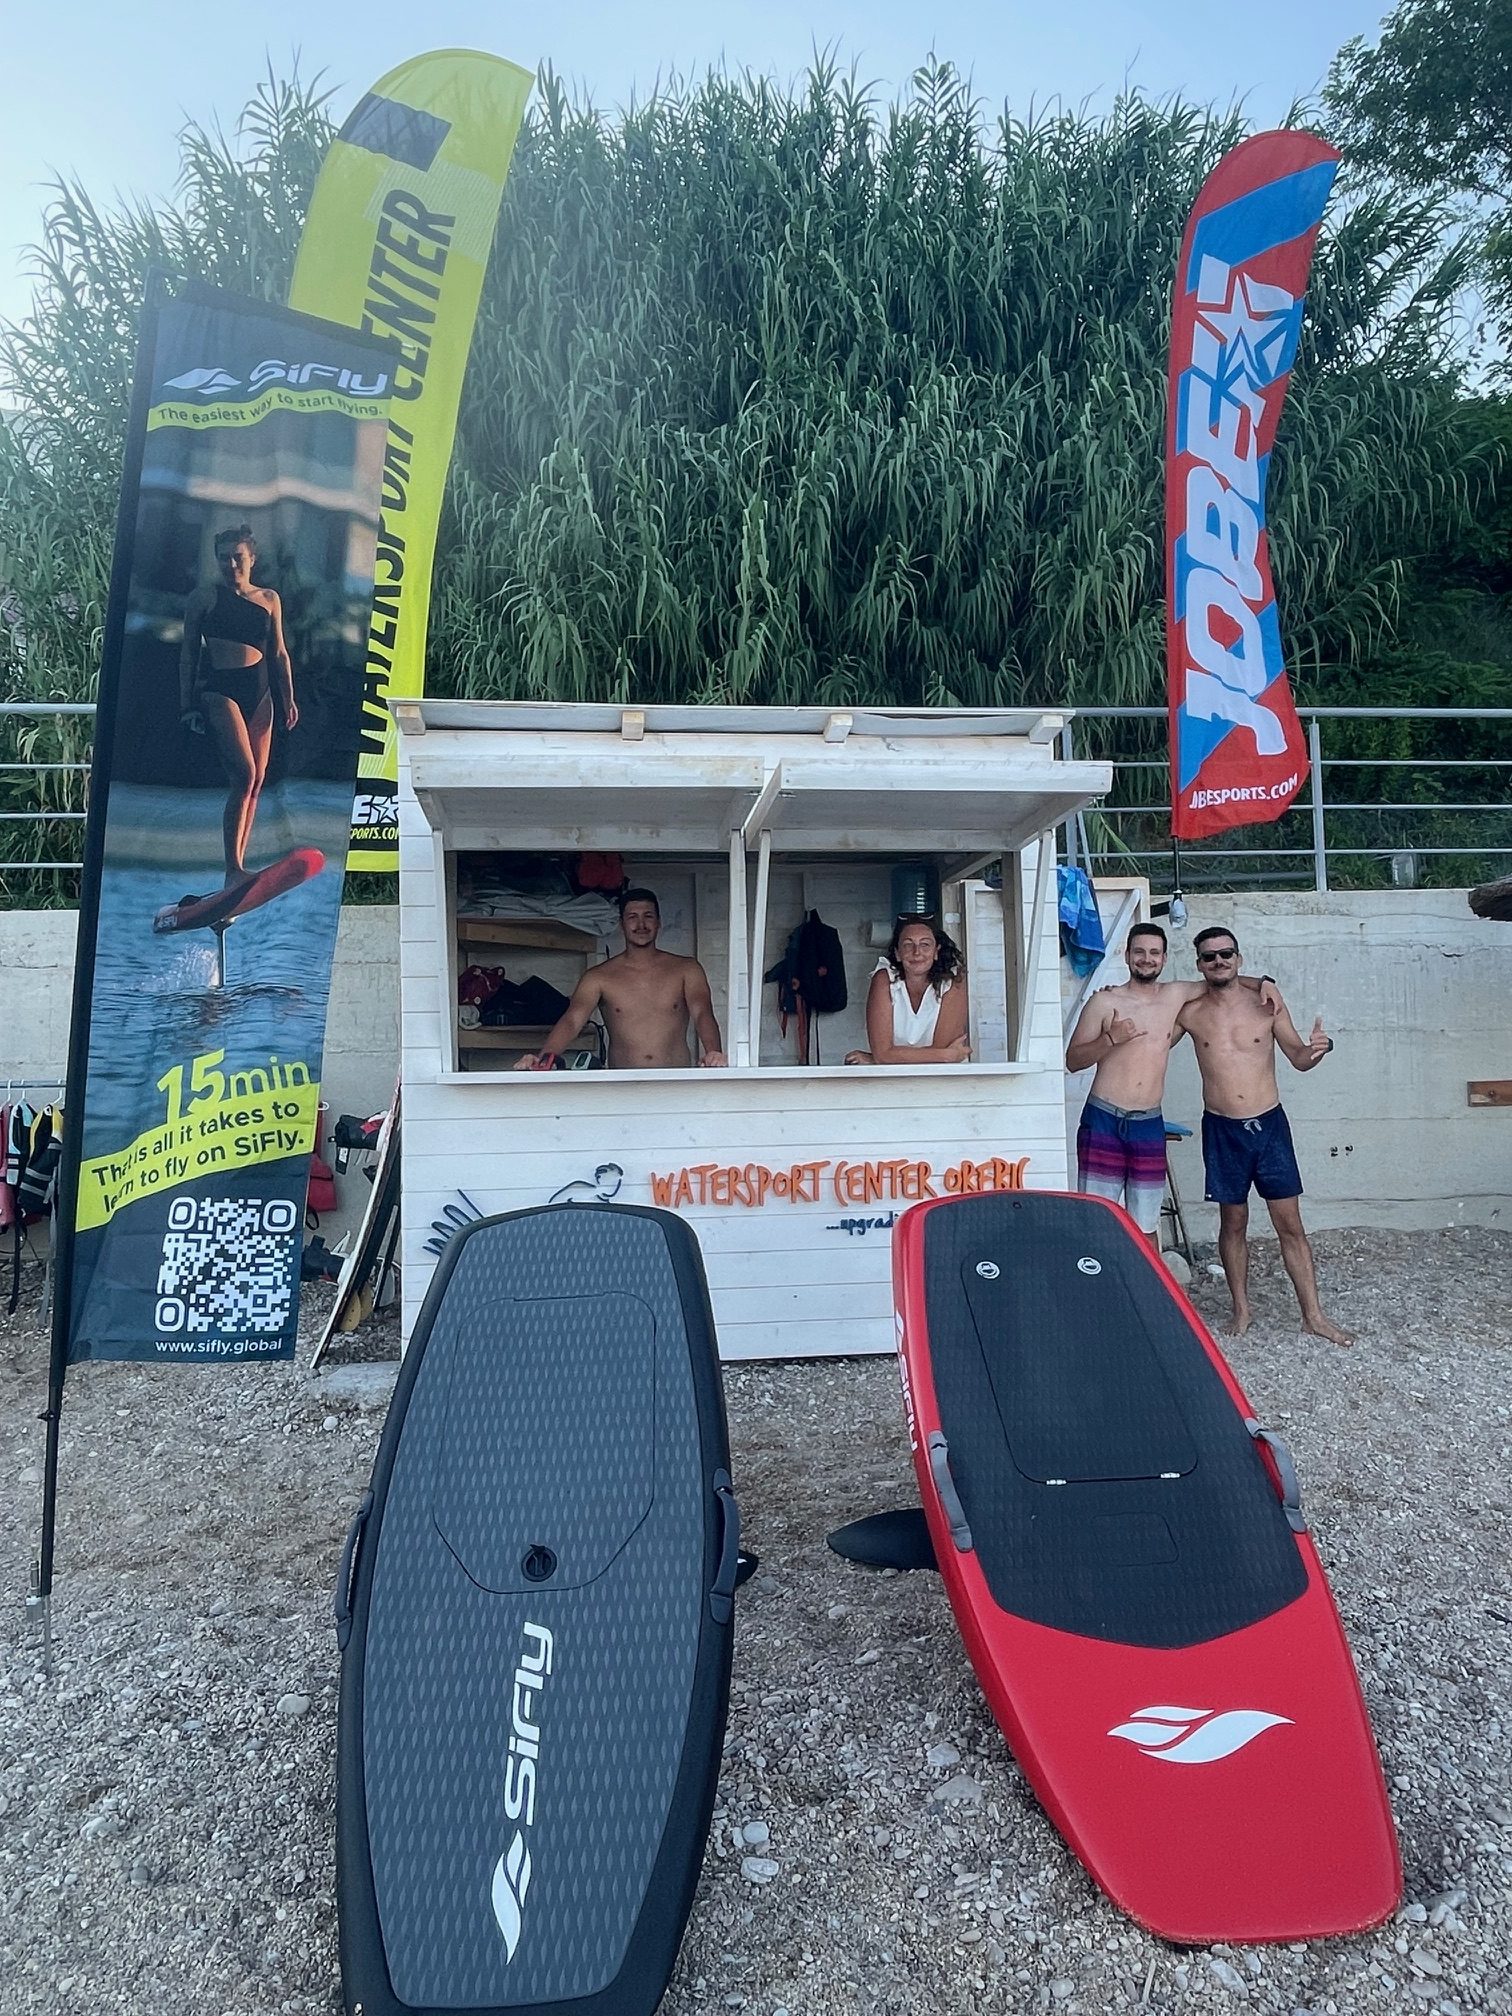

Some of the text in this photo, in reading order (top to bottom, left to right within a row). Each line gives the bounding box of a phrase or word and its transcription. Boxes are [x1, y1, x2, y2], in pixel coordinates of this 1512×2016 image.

[247, 359, 388, 395] SiFly
[158, 407, 188, 421] The
[192, 407, 247, 424] easiest
[250, 398, 272, 418] way
[277, 392, 294, 405] to
[297, 396, 335, 409] start
[1186, 374, 1288, 756] JOBE
[1189, 773, 1298, 809] JBESPORTS.COM
[134, 1145, 148, 1164] is
[152, 1130, 174, 1155] all
[180, 1124, 193, 1145] it
[199, 1106, 265, 1136] takes
[272, 1101, 300, 1120] to
[103, 1129, 305, 1212] lern to fly on SiFly.
[651, 1161, 831, 1207] WATERSPORT
[834, 1158, 937, 1207] CENTER
[826, 1211, 899, 1236] ...upgrad
[155, 1338, 282, 1355] www.sifly.global
[504, 1621, 554, 1826] SiFly
